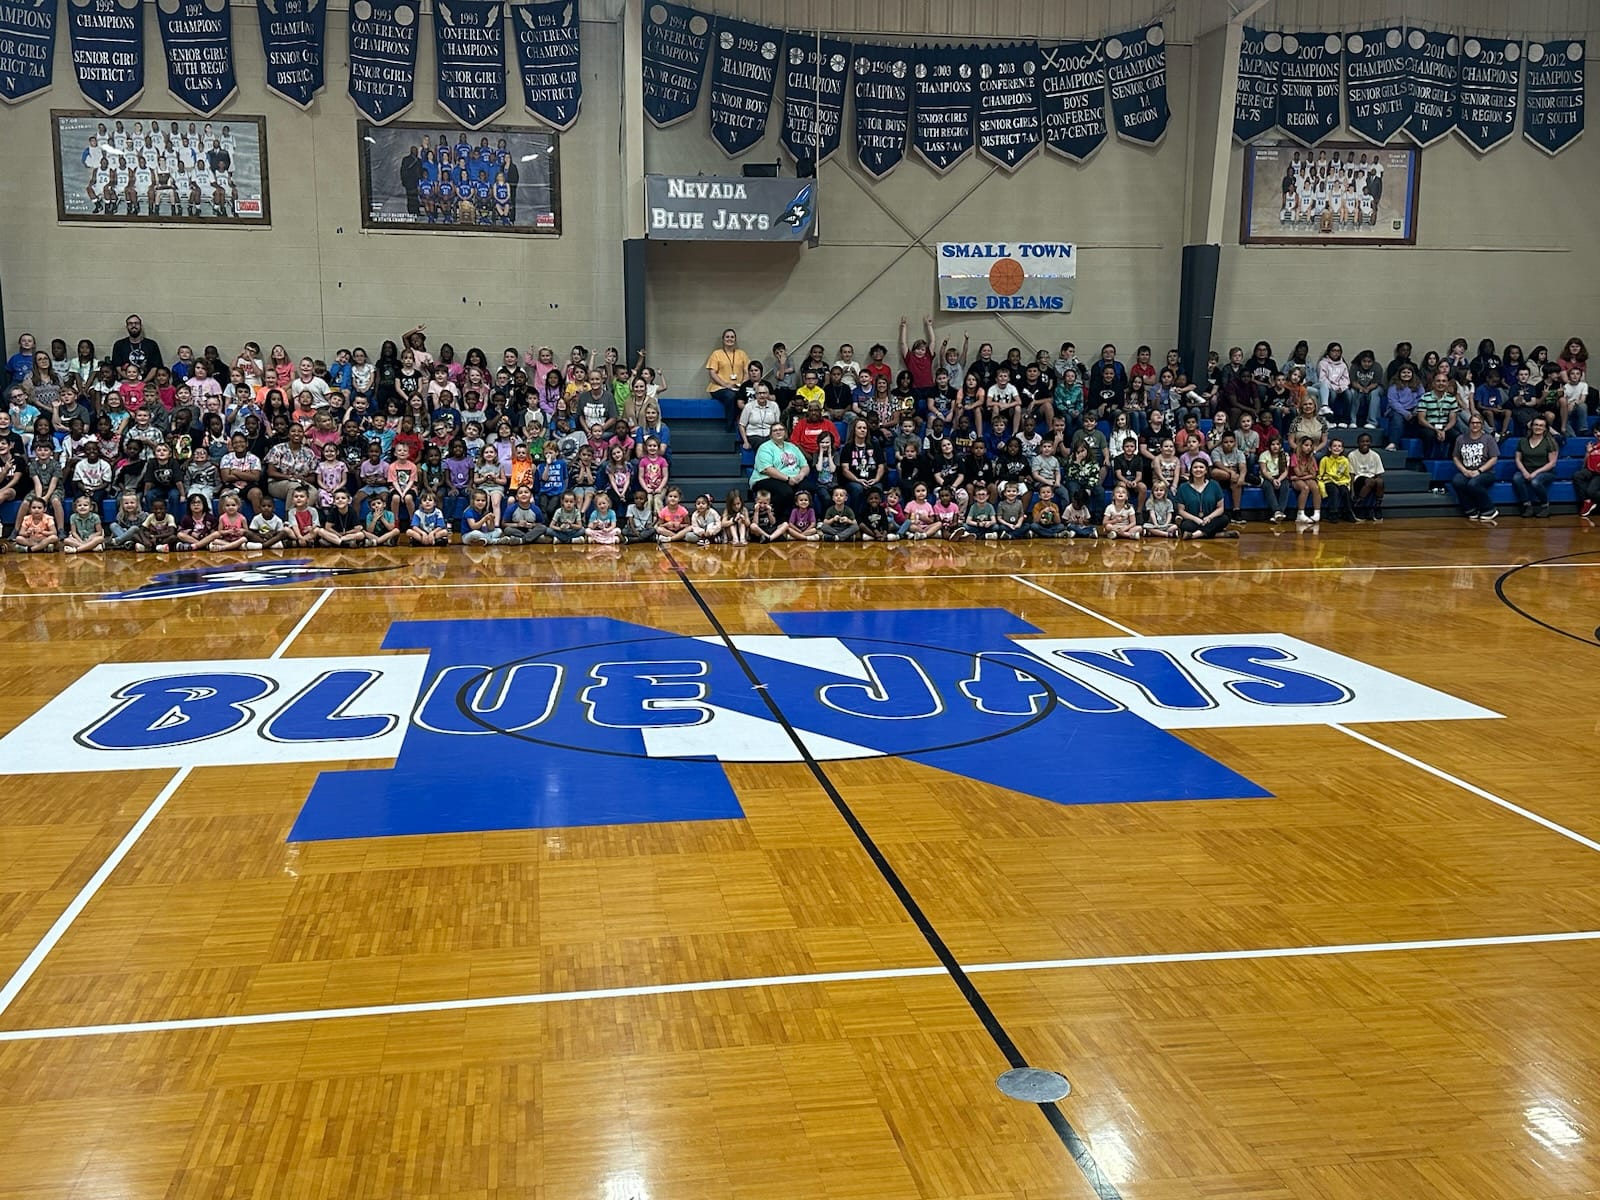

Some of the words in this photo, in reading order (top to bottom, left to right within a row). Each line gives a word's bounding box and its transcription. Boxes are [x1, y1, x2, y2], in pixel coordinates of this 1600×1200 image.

[77, 14, 135, 30] CHAMPIONS
[169, 20, 222, 33] CHAMPIONS
[18, 43, 47, 60] GIRLS
[354, 36, 410, 55] CHAMPIONS
[442, 43, 498, 56] CHAMPIONS
[526, 44, 579, 58] CHAMPIONS
[738, 38, 758, 52] 1995
[1122, 41, 1148, 60] 2007
[1364, 42, 1386, 58] 2011
[1423, 42, 1445, 60] 2011
[74, 50, 109, 65] SENIOR
[1298, 46, 1324, 60] 2007
[1479, 50, 1504, 66] 2012
[1542, 53, 1567, 68] 2012
[1058, 56, 1087, 73] 2006
[1109, 52, 1166, 81] CHAMPIONS
[1281, 62, 1339, 78] CHAMPIONS
[1348, 57, 1405, 78] CHAMPIONS
[1405, 57, 1458, 79] CHAMPIONS
[80, 67, 124, 81] DISTRICT
[352, 63, 380, 79] ENIOR
[383, 67, 413, 82] GIRLS
[525, 73, 558, 86] SENIOR
[1461, 66, 1518, 85] CHAMPIONS
[1528, 70, 1584, 86] CHAMPIONS
[6, 77, 16, 91] N
[185, 77, 213, 90] CLASS
[216, 77, 223, 90] A
[671, 74, 697, 91] GIRLS
[916, 82, 971, 93] CHAMPIONS
[1043, 69, 1105, 93] CHAMPIONS
[1112, 80, 1145, 100] SENIOR
[1146, 74, 1166, 91] GIRL
[107, 90, 114, 102] N
[446, 86, 486, 99] DISTRICT
[531, 87, 573, 101] DISTRICT
[1281, 84, 1312, 97] SENIOR
[1317, 84, 1339, 97] BOYS
[1349, 88, 1381, 102] SENIOR
[1381, 82, 1407, 99] GIRLS
[1431, 88, 1457, 103] GIRLS
[202, 94, 209, 106] N
[375, 100, 382, 113] N
[745, 98, 768, 114] BOYS
[982, 93, 1032, 108] CHAMPIONS
[1063, 94, 1089, 110] BOYS
[1373, 100, 1403, 115] SOUTH
[1460, 93, 1490, 106] SENIOR
[1490, 94, 1517, 108] GIRLS
[1527, 97, 1556, 109] SENIOR
[1556, 94, 1584, 109] GIRLS
[467, 104, 476, 118] N
[556, 106, 565, 119] N
[946, 112, 968, 123] GIRLS
[1046, 107, 1105, 126] CONFERENC
[1123, 106, 1159, 128] REGION
[1471, 109, 1502, 123] REGION
[1504, 111, 1513, 124] 5
[1546, 111, 1577, 125] SOUTH
[885, 118, 906, 131] BOYS
[980, 119, 1012, 131] SENIOR
[1013, 116, 1038, 129] GIRLS
[1286, 112, 1319, 127] REGION
[1326, 113, 1333, 126] 6
[1377, 119, 1383, 131] N
[1422, 119, 1429, 131] N
[1047, 126, 1060, 141] 2A
[1481, 126, 1489, 138] N
[1549, 128, 1556, 141] N
[859, 135, 895, 149] STRICT
[981, 133, 1021, 147] DISTRICT
[875, 152, 882, 164] N
[940, 155, 947, 166] N
[1008, 150, 1015, 160] N
[667, 178, 748, 200] NEVADA
[651, 207, 705, 230] BLUE
[712, 208, 770, 231] JAYS
[942, 244, 1011, 258] SMALL
[1019, 244, 1072, 258] TOWN
[946, 296, 978, 309] BIG
[986, 295, 1064, 310] DREAMS
[74, 661, 714, 752] BLUE
[818, 643, 1356, 720] JAYS
